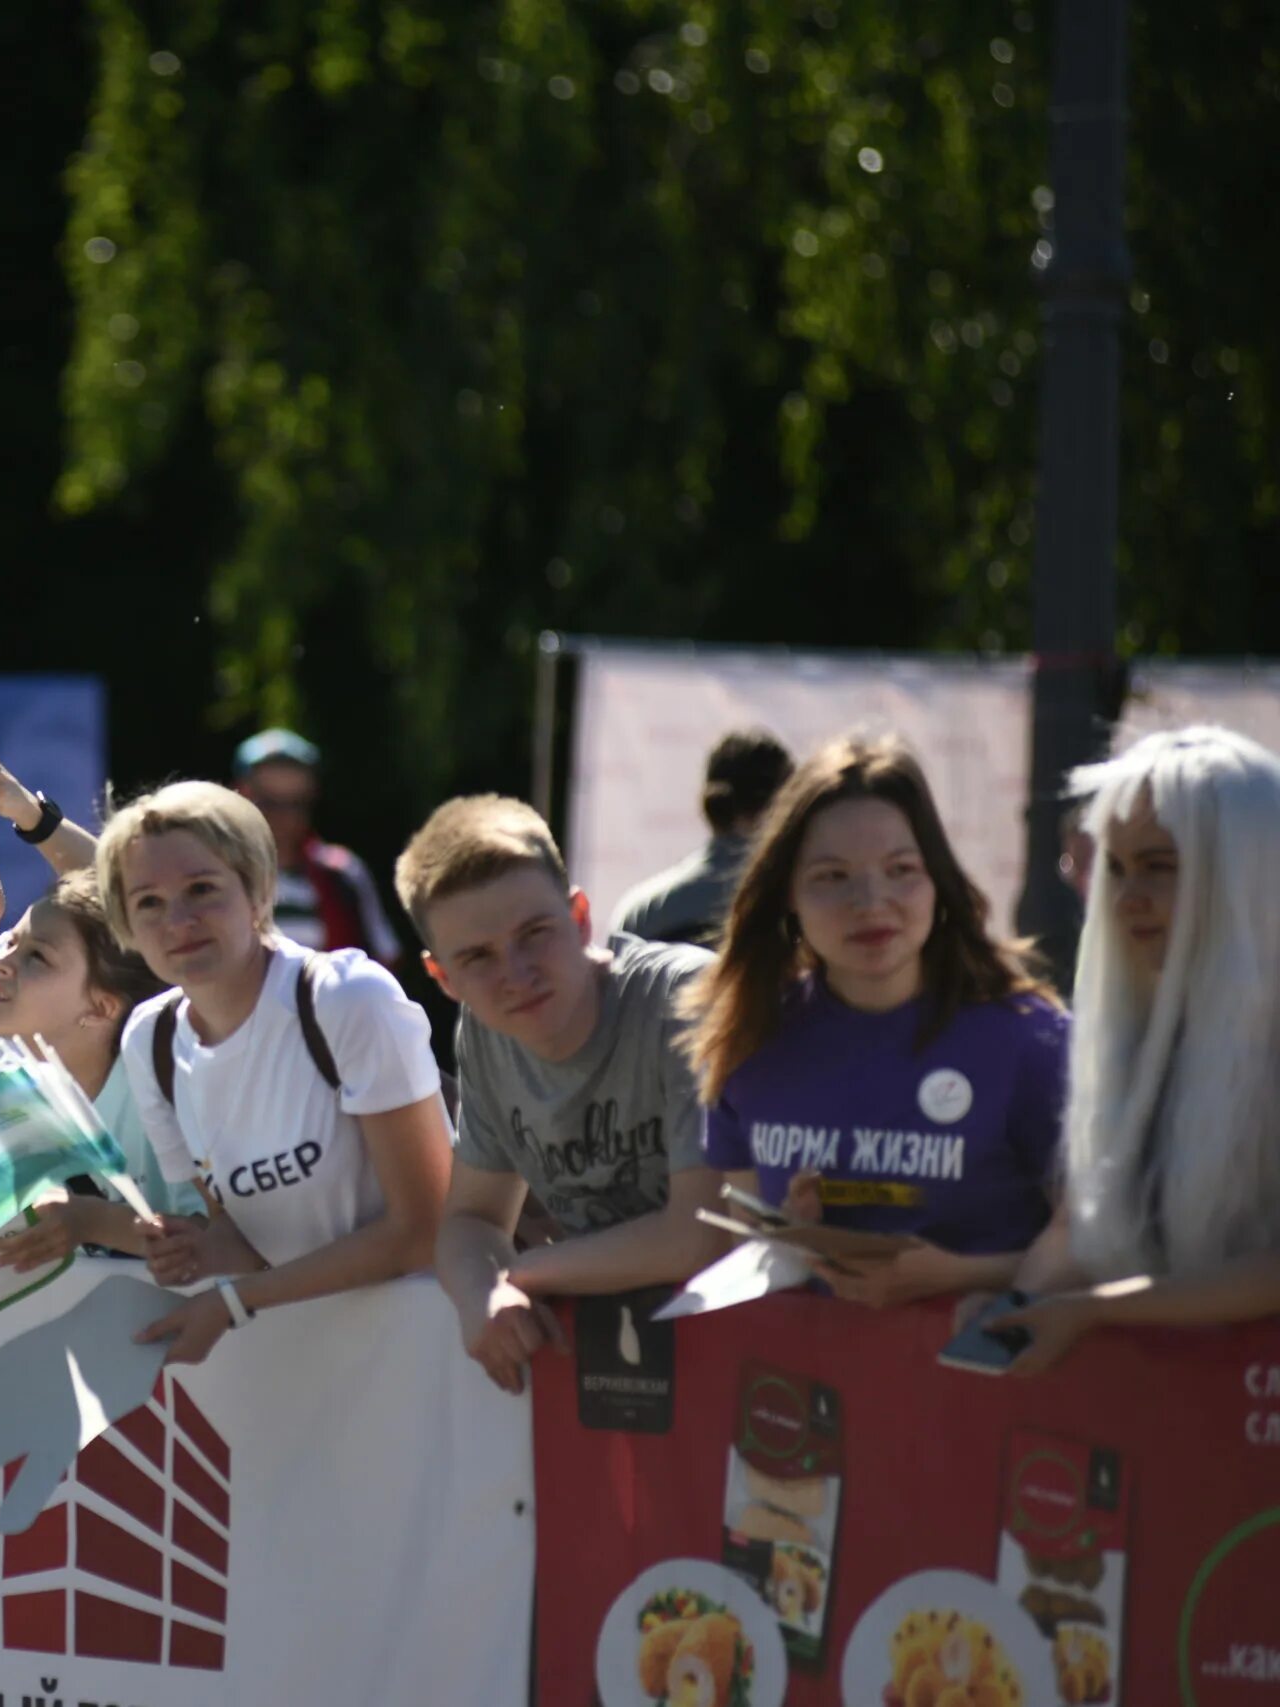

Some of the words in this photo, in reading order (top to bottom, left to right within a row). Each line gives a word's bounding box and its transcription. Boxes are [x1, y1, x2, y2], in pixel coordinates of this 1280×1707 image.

[229, 1141, 323, 1198] СБЕР
[750, 1121, 842, 1170] НОРМА
[850, 1125, 965, 1182] ЖИЗНИ
